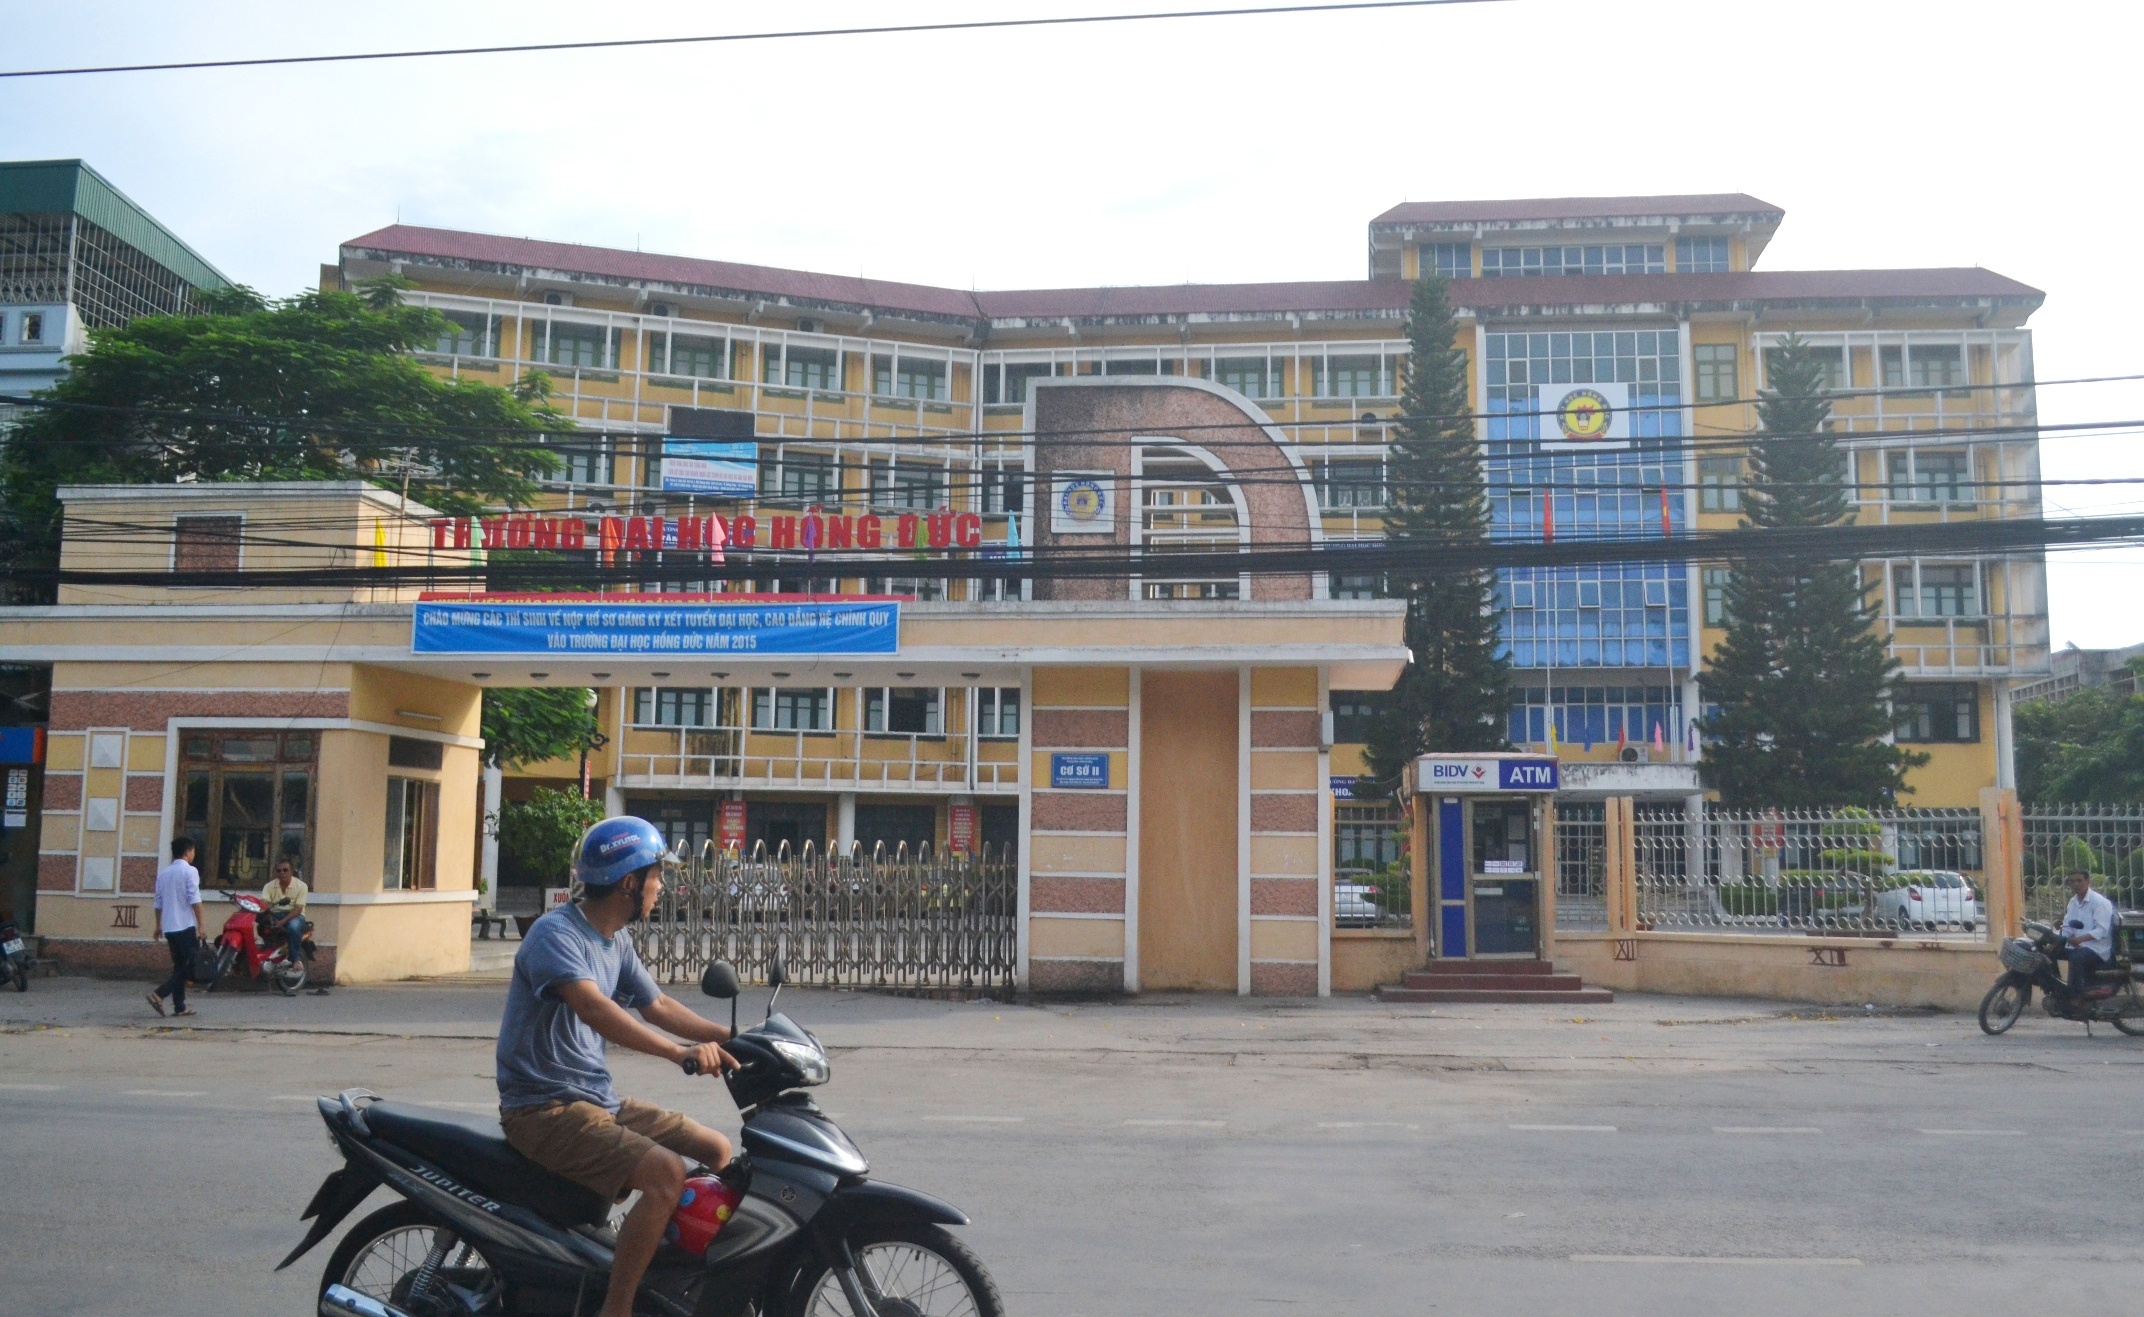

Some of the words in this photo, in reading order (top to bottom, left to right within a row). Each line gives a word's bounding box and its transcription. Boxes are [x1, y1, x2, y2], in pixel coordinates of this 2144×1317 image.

[897, 506, 981, 549] ĐỨC
[423, 609, 449, 626] CHÀO
[451, 610, 481, 626] MỪNG
[483, 609, 503, 627] CÁC
[505, 610, 521, 627] THÍ
[523, 612, 546, 627] SINH
[548, 608, 562, 627] VỀ
[563, 610, 583, 630] NỘP
[585, 608, 601, 627] HỒ
[602, 612, 617, 627] SƠ
[618, 610, 646, 627] ĐĂNG
[649, 610, 662, 627] KÝ
[664, 610, 682, 627] XÉT
[685, 608, 717, 627] TUYỂN
[718, 612, 736, 630] ĐẠI
[738, 612, 762, 630] HỌC,
[765, 612, 786, 627] CAO
[788, 606, 817, 627] ĐẲNG
[819, 609, 832, 630] HỆ
[835, 609, 866, 627] CHÍNH
[868, 611, 890, 627] QUY
[547, 631, 567, 649] VÀO
[569, 631, 608, 649] TRƯỜNG
[610, 634, 628, 652] ĐẠI
[630, 634, 650, 652] HỌC
[652, 630, 681, 649] HỒNG
[682, 630, 703, 649] ĐỨC
[705, 633, 730, 649] NĂM
[732, 634, 757, 649] 2015
[1060, 765, 1074, 776] CƠ
[1076, 764, 1090, 776] SỞ
[1091, 766, 1100, 776] II
[1433, 764, 1469, 778] BIDV
[1509, 766, 1551, 783] ATM
[111, 905, 140, 928] XIII
[1613, 939, 1635, 961] XII
[409, 1165, 500, 1212] JUPITER
